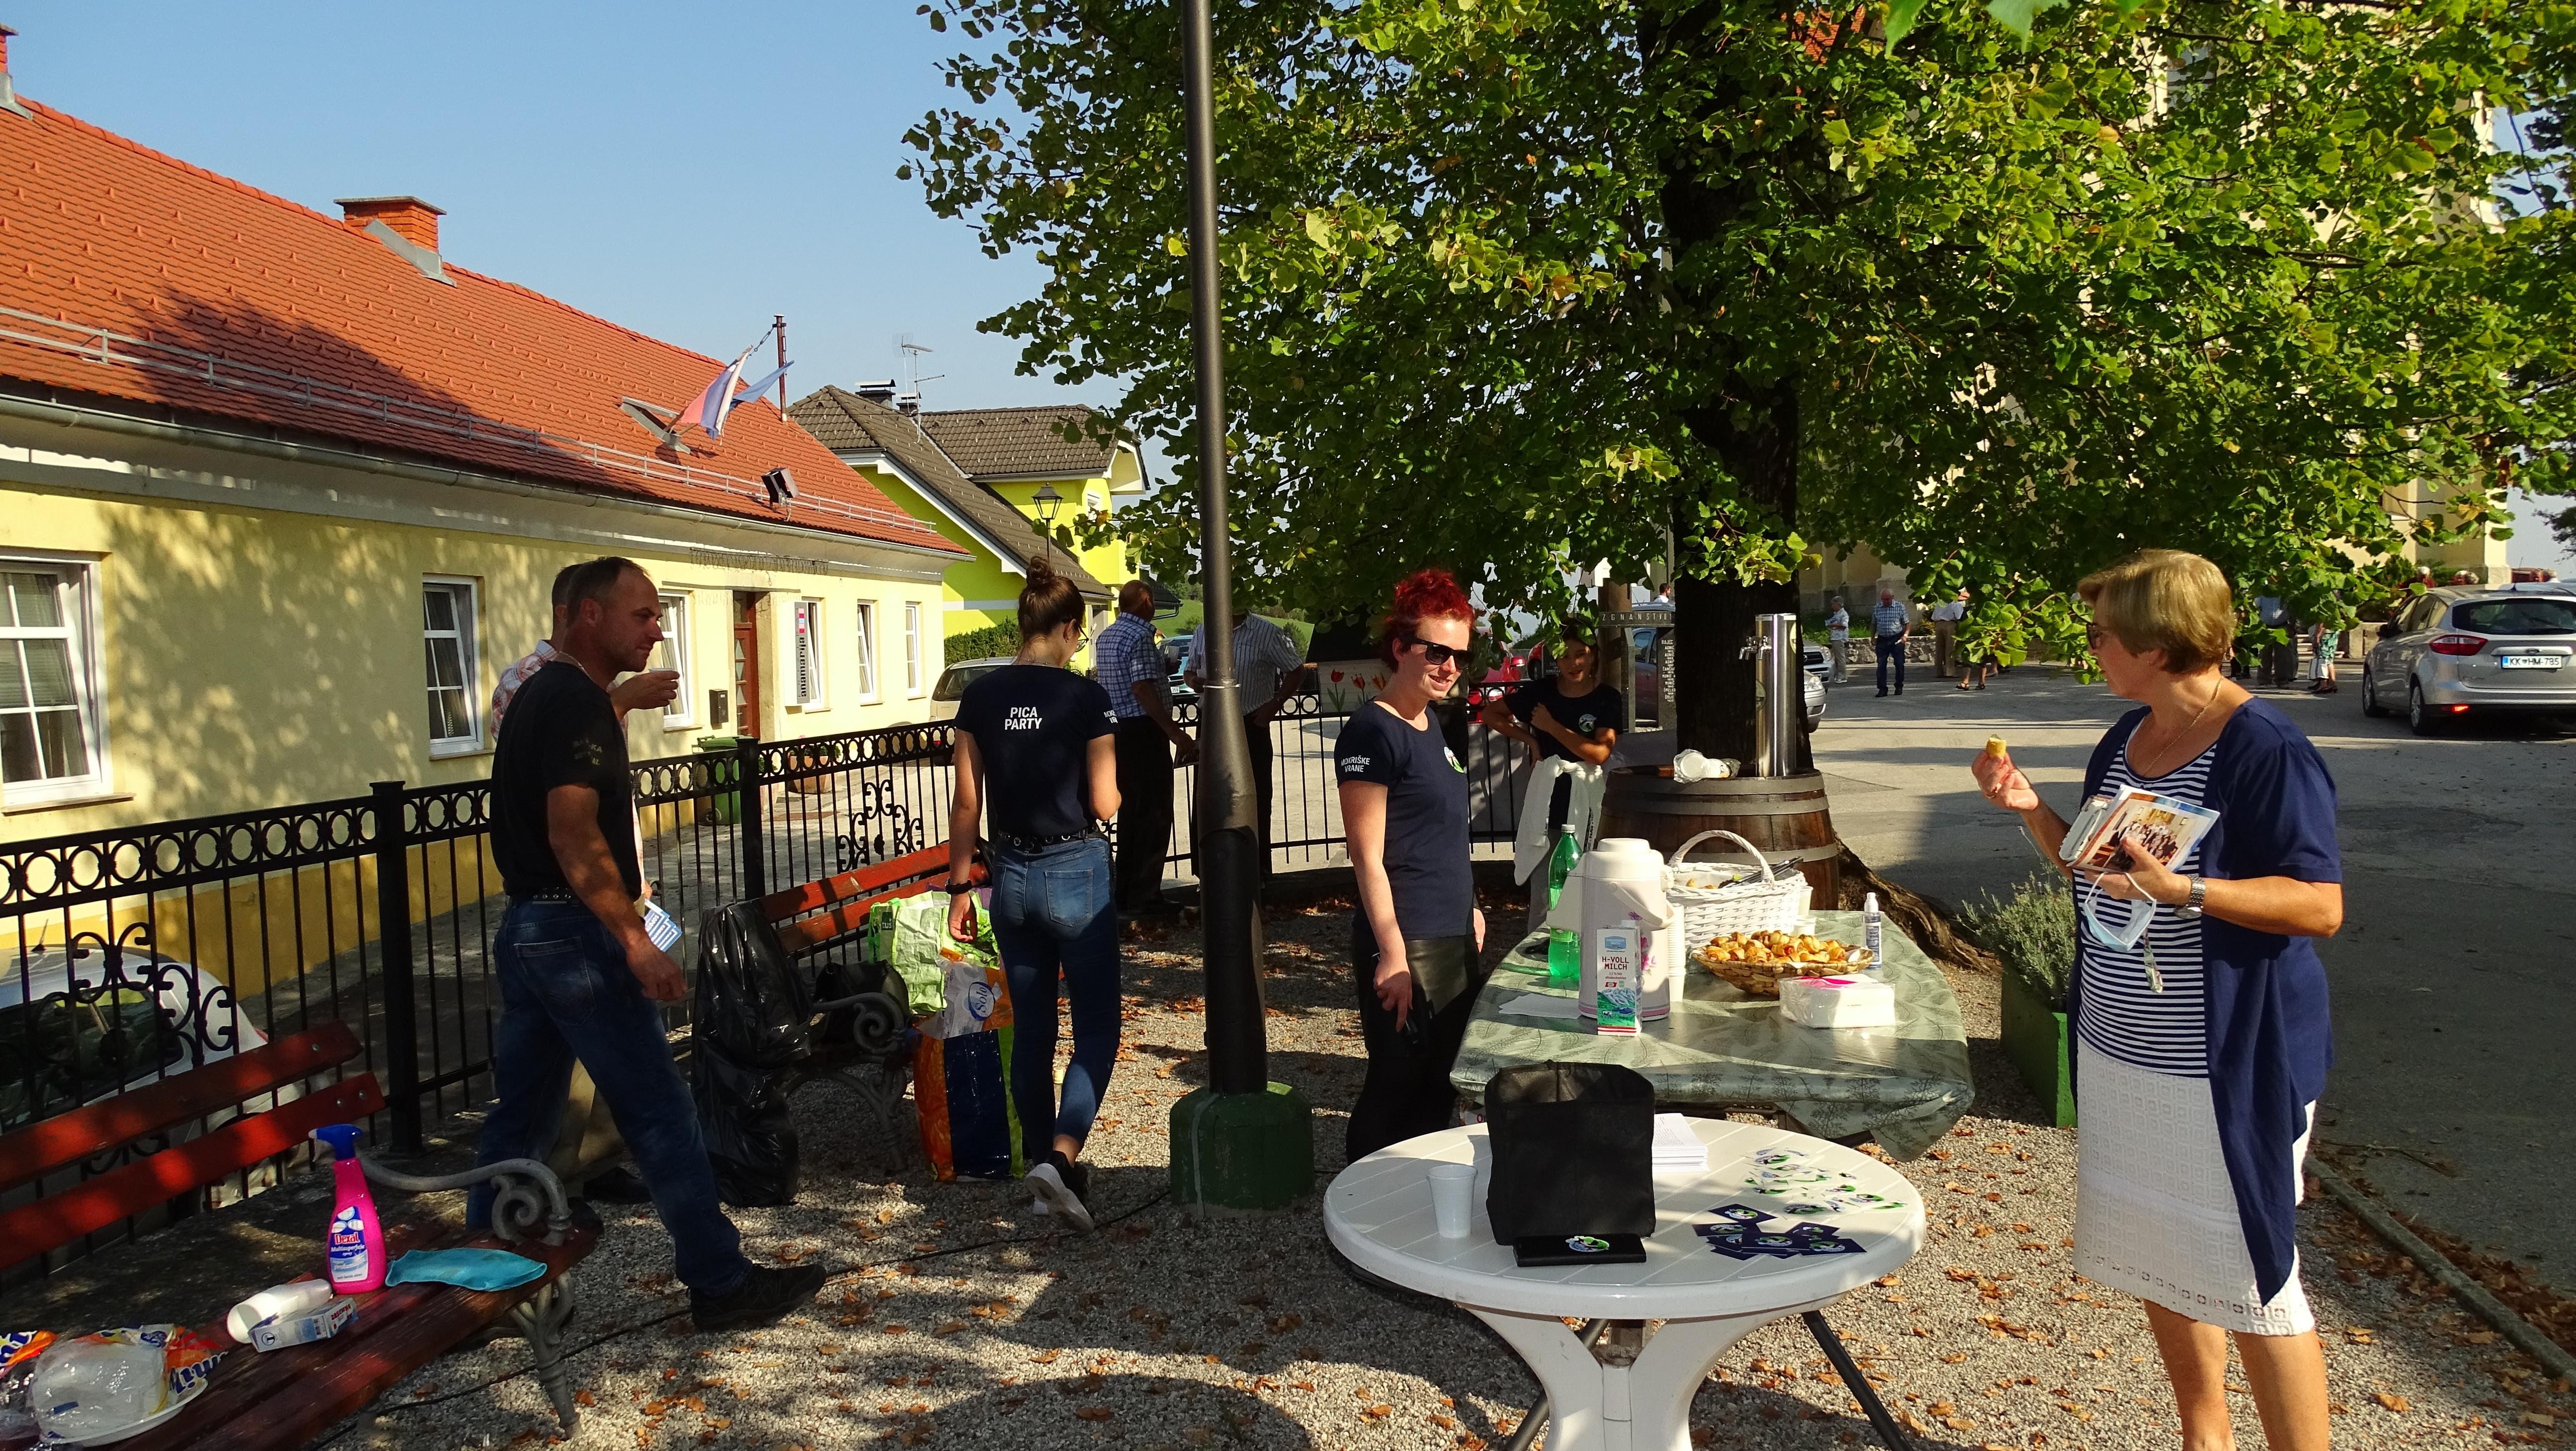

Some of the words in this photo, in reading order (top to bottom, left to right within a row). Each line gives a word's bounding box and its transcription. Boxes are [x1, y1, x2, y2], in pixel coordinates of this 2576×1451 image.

[1010, 707, 1038, 718] PICA
[1005, 718, 1043, 730] PARTY
[1341, 755, 1370, 766] MOKRIŠKE
[975, 987, 987, 1013] Solo
[335, 1232, 360, 1245] Dexal
